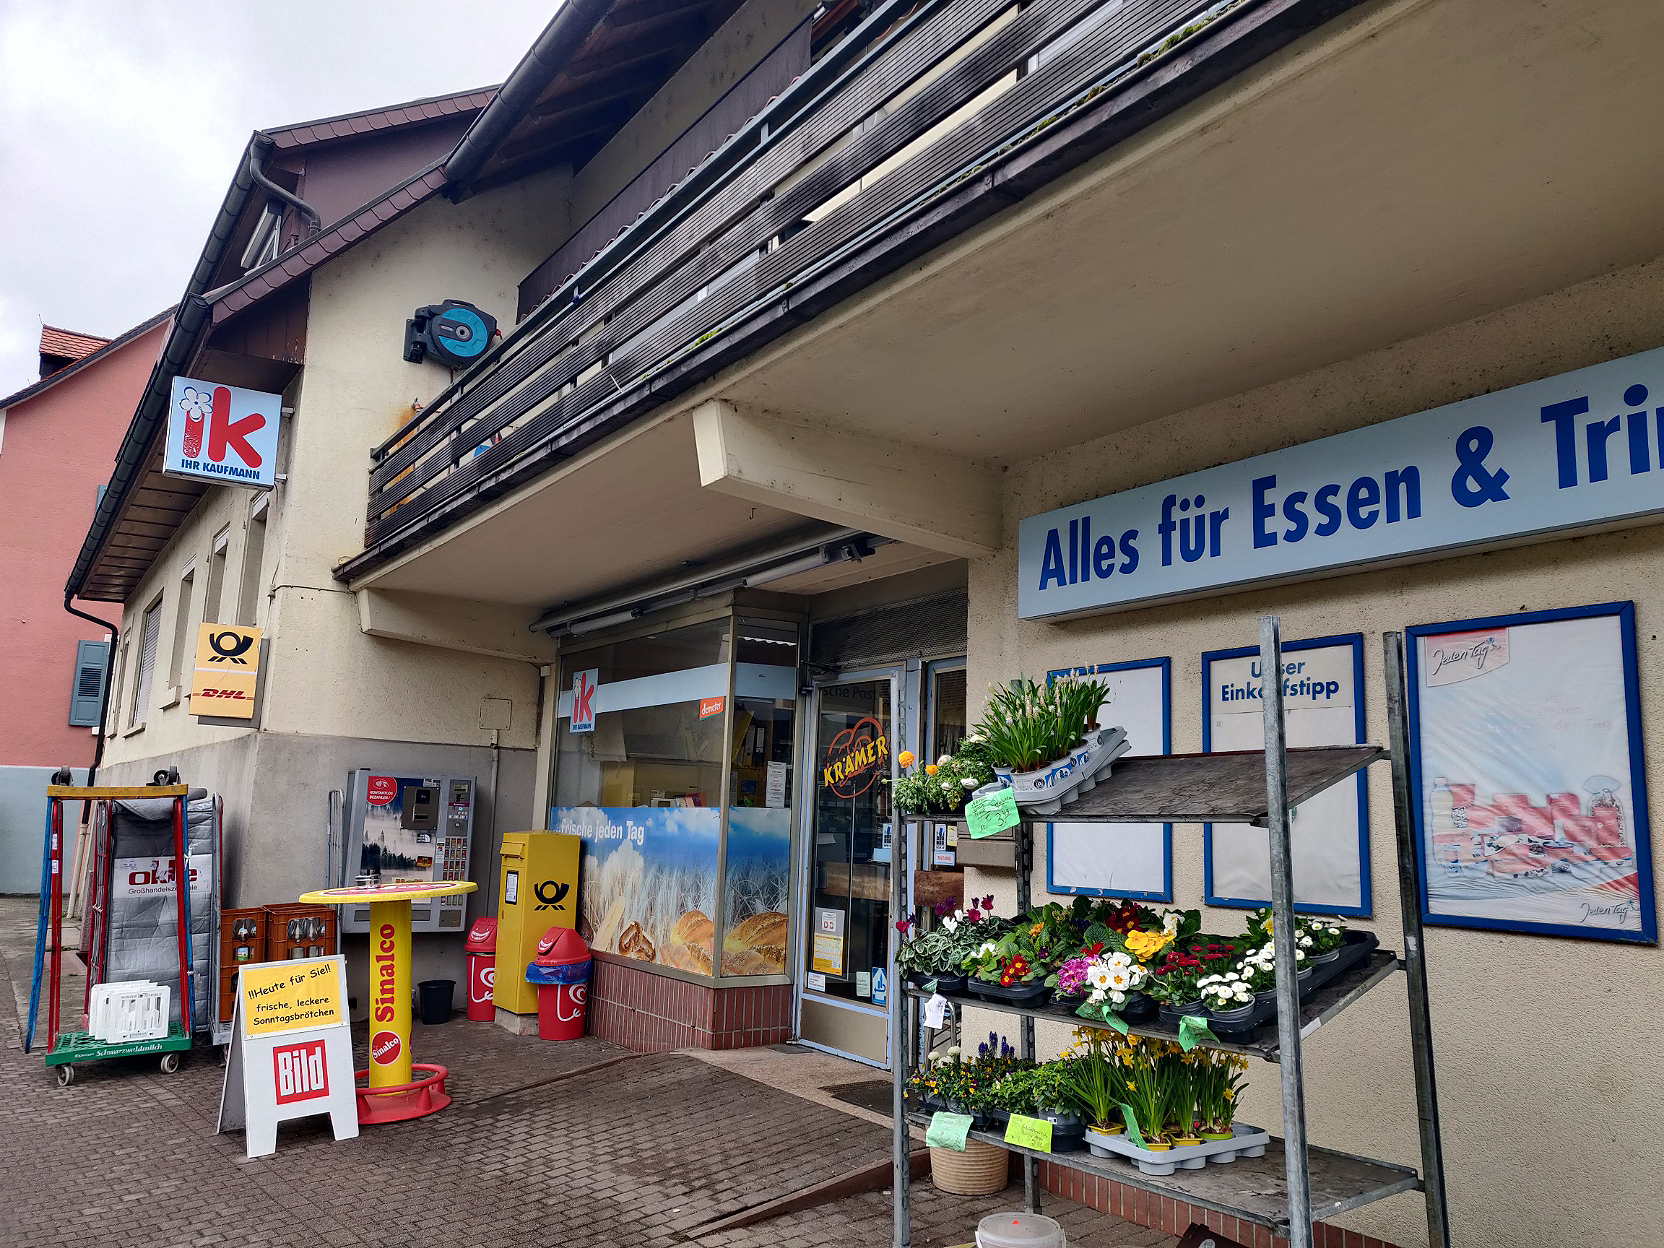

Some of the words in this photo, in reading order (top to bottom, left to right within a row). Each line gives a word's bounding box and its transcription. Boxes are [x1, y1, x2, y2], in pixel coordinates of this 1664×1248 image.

[181, 386, 267, 469] ik
[181, 458, 200, 471] IHR
[202, 462, 261, 480] KAUFMANN
[1039, 516, 1140, 590] Alles
[1158, 494, 1229, 566] für
[1252, 464, 1421, 549] Essen
[1451, 424, 1511, 508] &
[1541, 384, 1664, 490] Tri
[1251, 661, 1306, 679] User
[1432, 648, 1468, 676] Jeden
[1468, 640, 1491, 670] Tag
[201, 688, 248, 700] DHL
[1221, 676, 1340, 702] Einkfstipp
[701, 700, 723, 717] demeter
[823, 735, 889, 788] KRÄMER
[594, 820, 624, 844] jeden
[626, 820, 645, 847] Tag
[1580, 902, 1611, 923] Jeden
[1611, 902, 1629, 925] Tag
[289, 974, 306, 986] für
[374, 923, 396, 1023] Sinalco
[256, 1001, 293, 1013] frische,
[297, 996, 330, 1007] leckere
[253, 1008, 335, 1026] Sonntagsbrötchen
[372, 1036, 400, 1060] Sinalco
[277, 1046, 325, 1097] Bild
